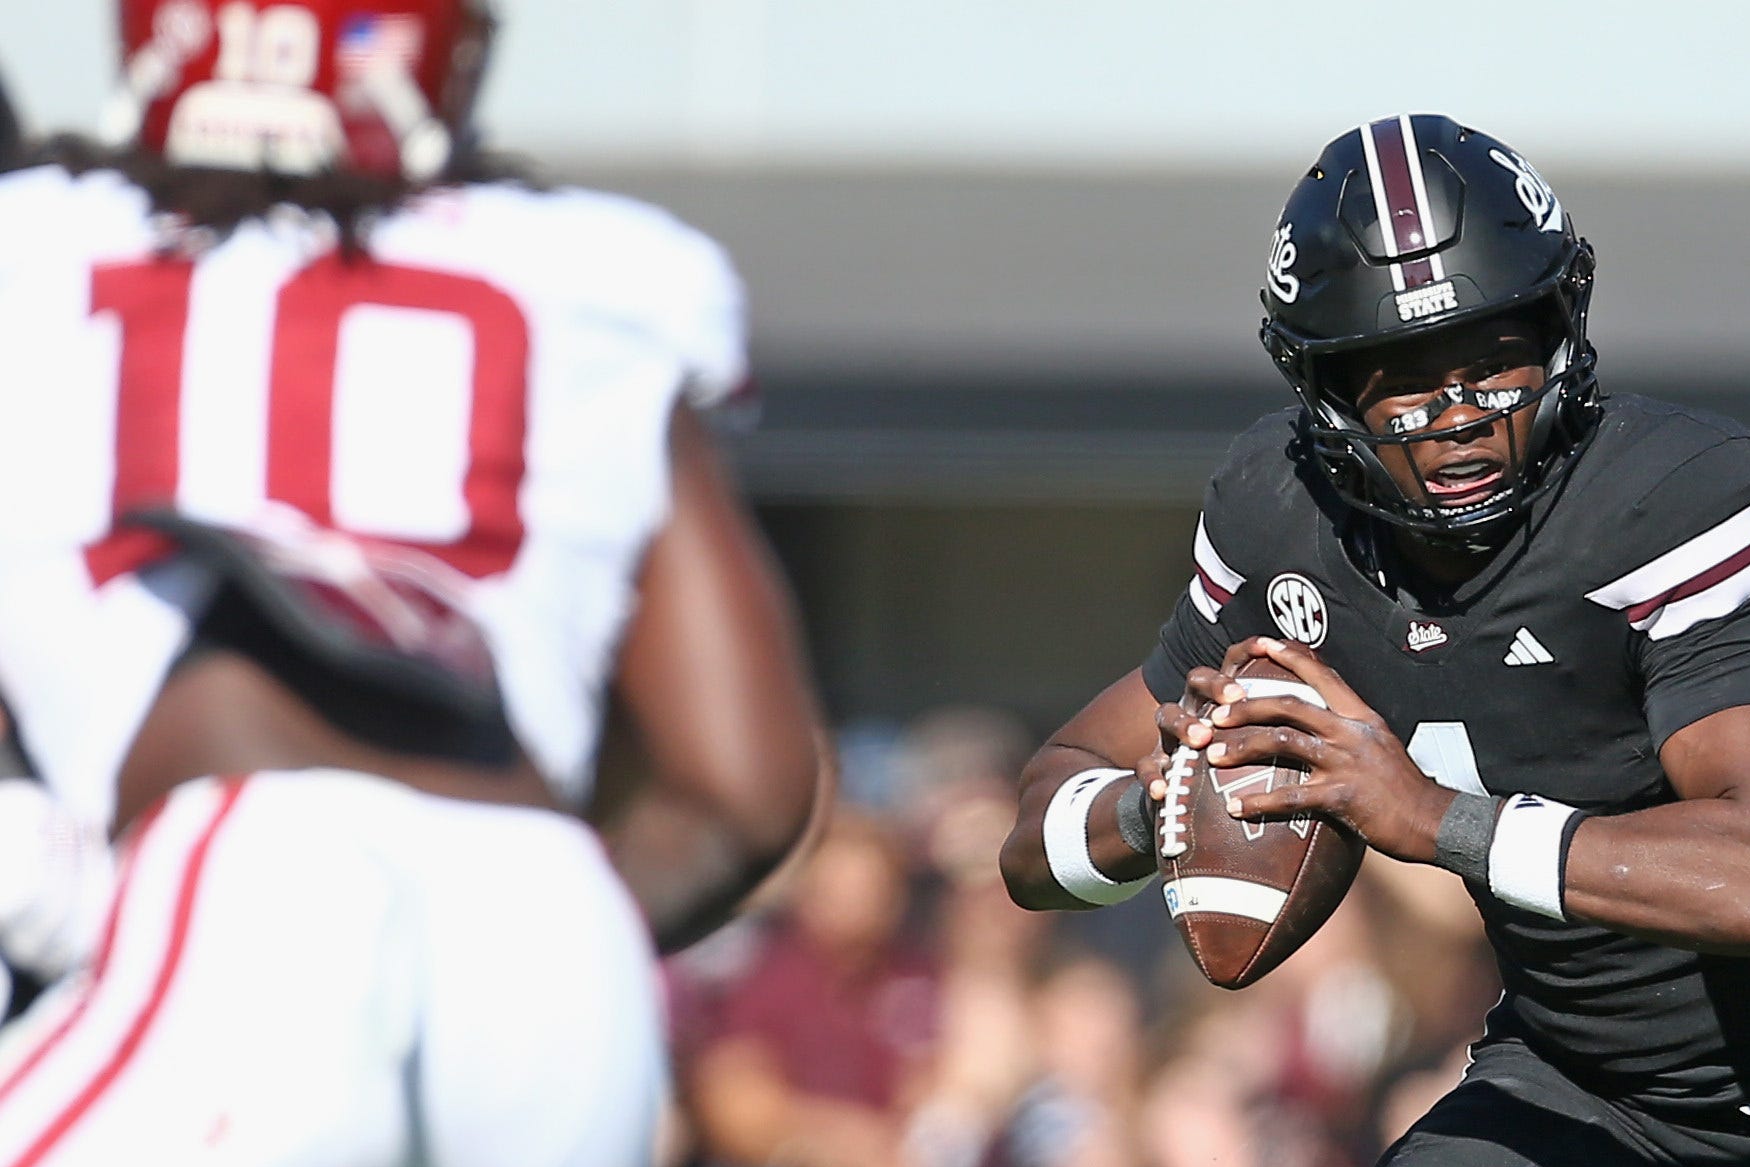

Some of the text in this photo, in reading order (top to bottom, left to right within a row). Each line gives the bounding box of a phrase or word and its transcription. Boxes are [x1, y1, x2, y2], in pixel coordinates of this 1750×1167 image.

[1397, 290, 1459, 322] STATE
[1475, 388, 1522, 409] BABY
[82, 250, 531, 591] 10
[1390, 408, 1429, 434] 283
[1269, 577, 1324, 645] SEC
[1406, 620, 1448, 652] State
